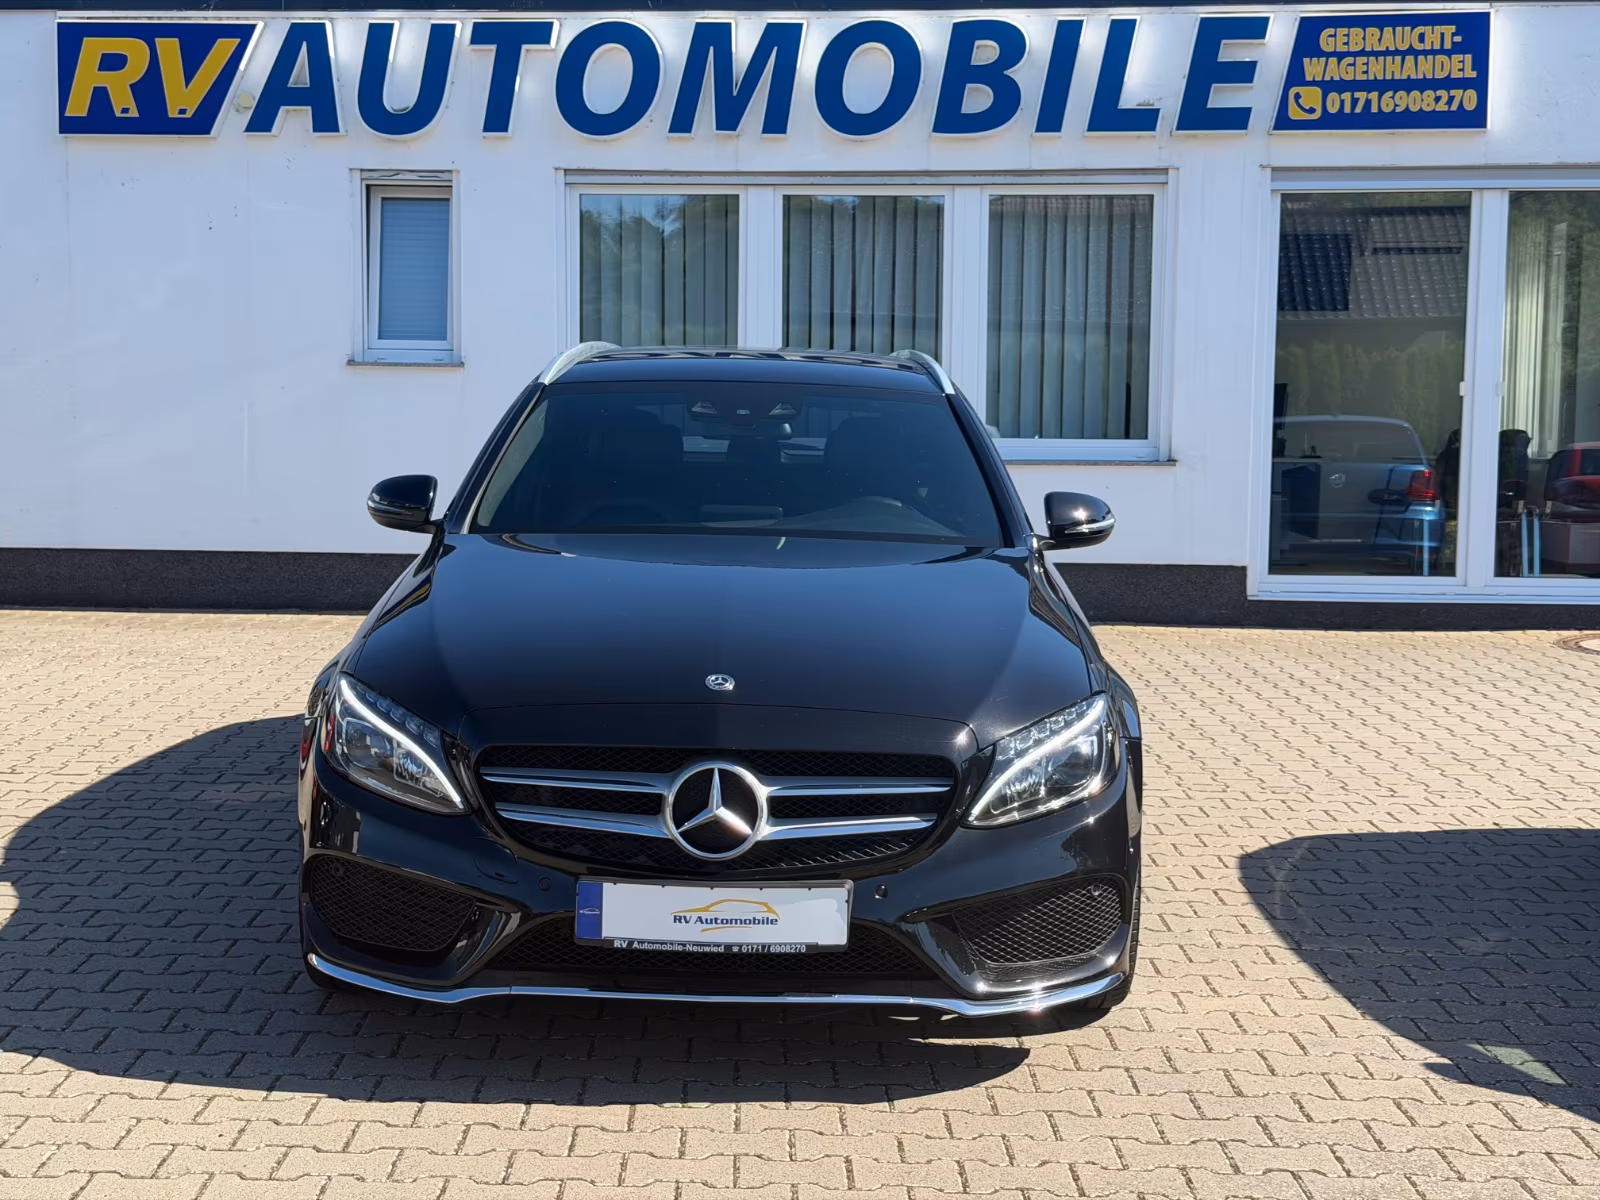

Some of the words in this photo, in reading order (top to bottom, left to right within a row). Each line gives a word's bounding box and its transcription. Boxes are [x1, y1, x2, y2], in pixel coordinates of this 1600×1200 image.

[1319, 25, 1462, 52] GEBRAUCHT-
[243, 15, 1272, 137] AUTOMOBILE
[1303, 54, 1477, 81] WAGENHANDEL
[1325, 89, 1478, 114] 01716908270
[673, 915, 692, 924] RV
[694, 915, 779, 926] Automobile
[613, 940, 628, 948] RV
[632, 941, 724, 953] Automobile-Neuwied
[741, 944, 762, 953] 0171
[769, 944, 806, 953] 6908270
